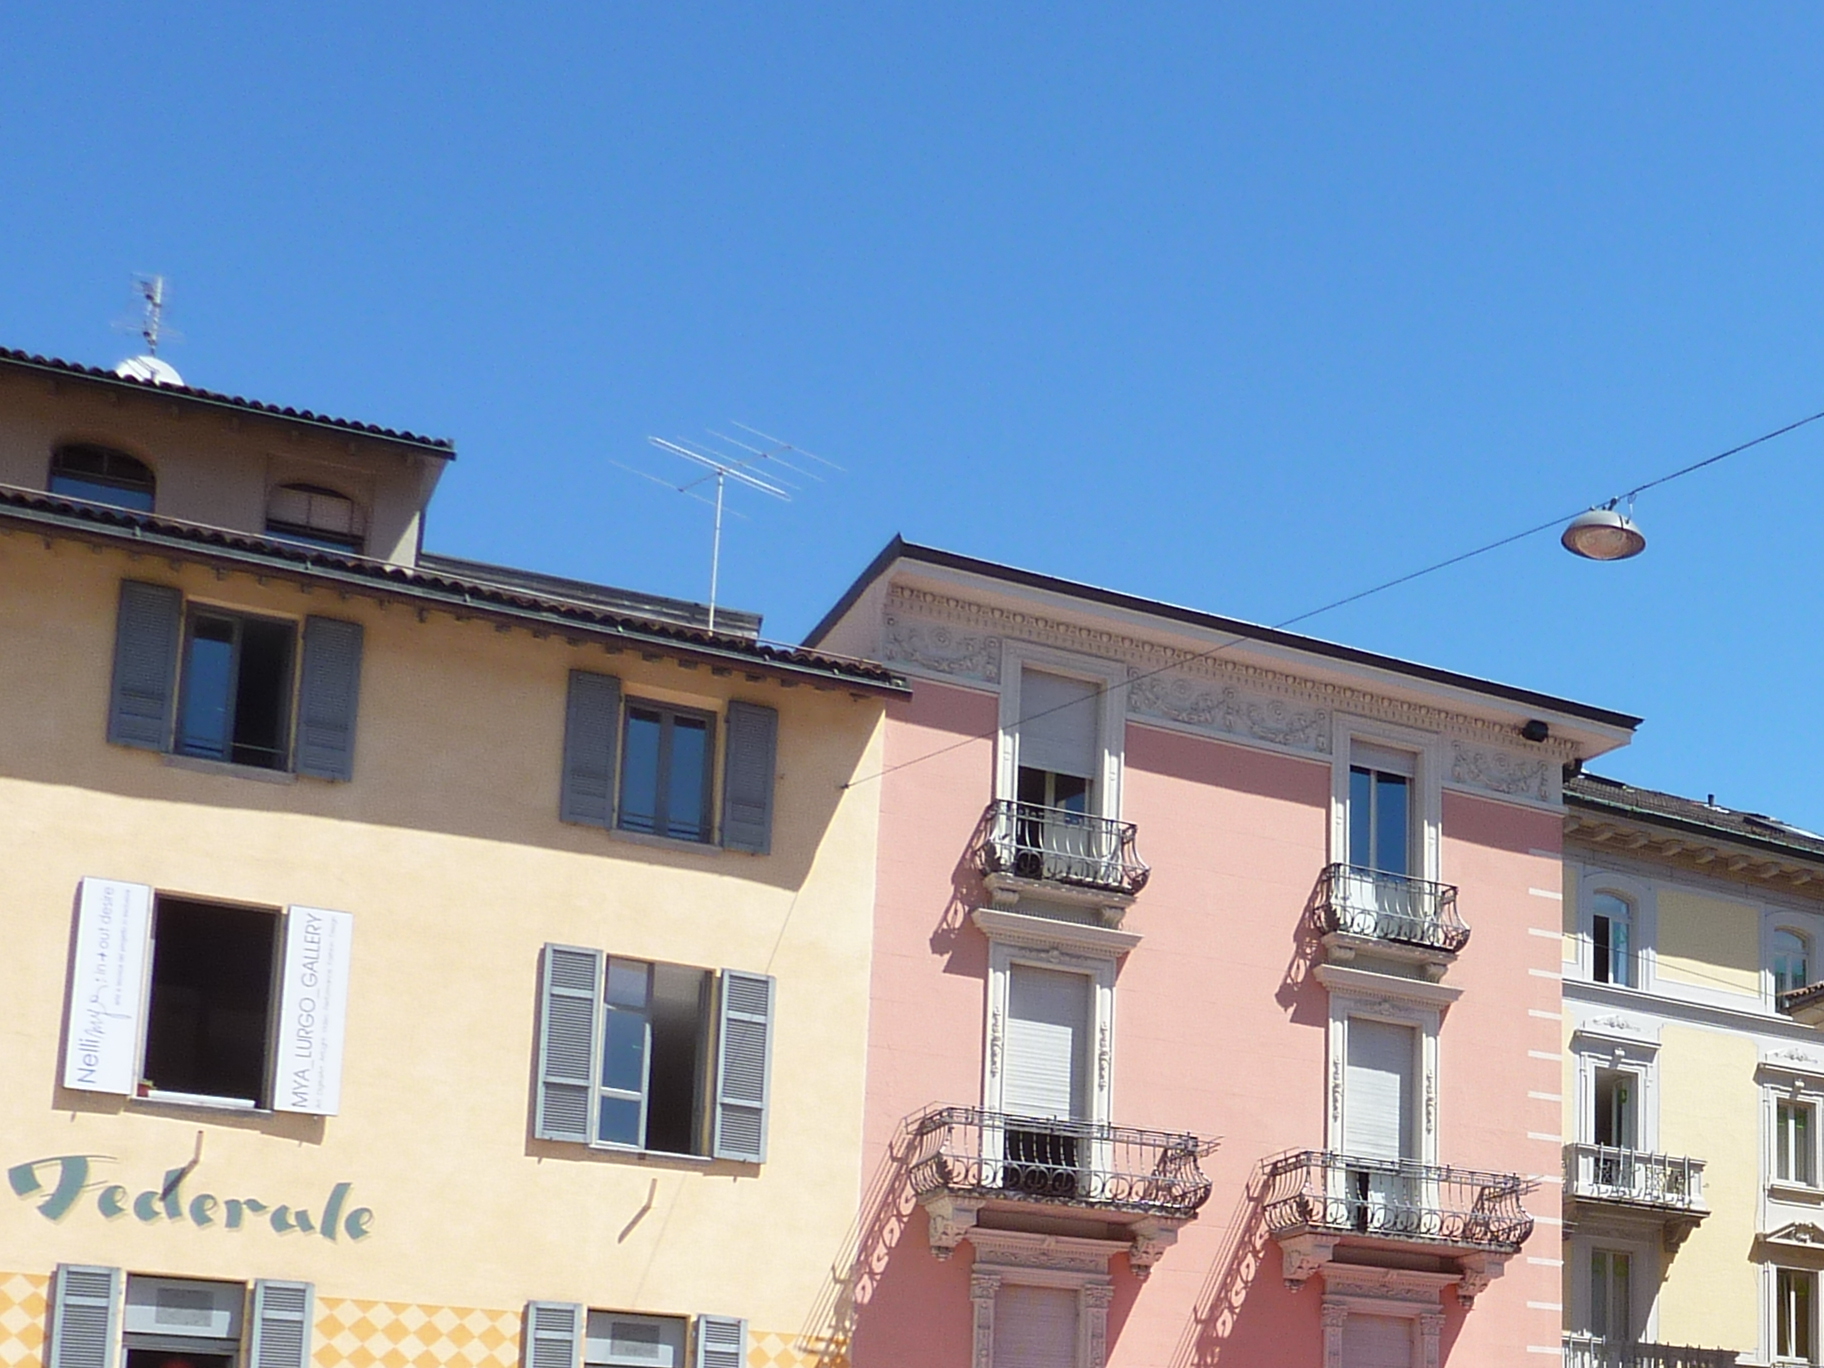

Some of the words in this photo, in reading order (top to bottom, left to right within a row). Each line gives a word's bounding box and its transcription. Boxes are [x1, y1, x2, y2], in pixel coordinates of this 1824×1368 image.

[98, 887, 115, 924] desire
[98, 927, 111, 949] out
[77, 1038, 101, 1084] Nelli
[8, 1155, 375, 1241] Federale
